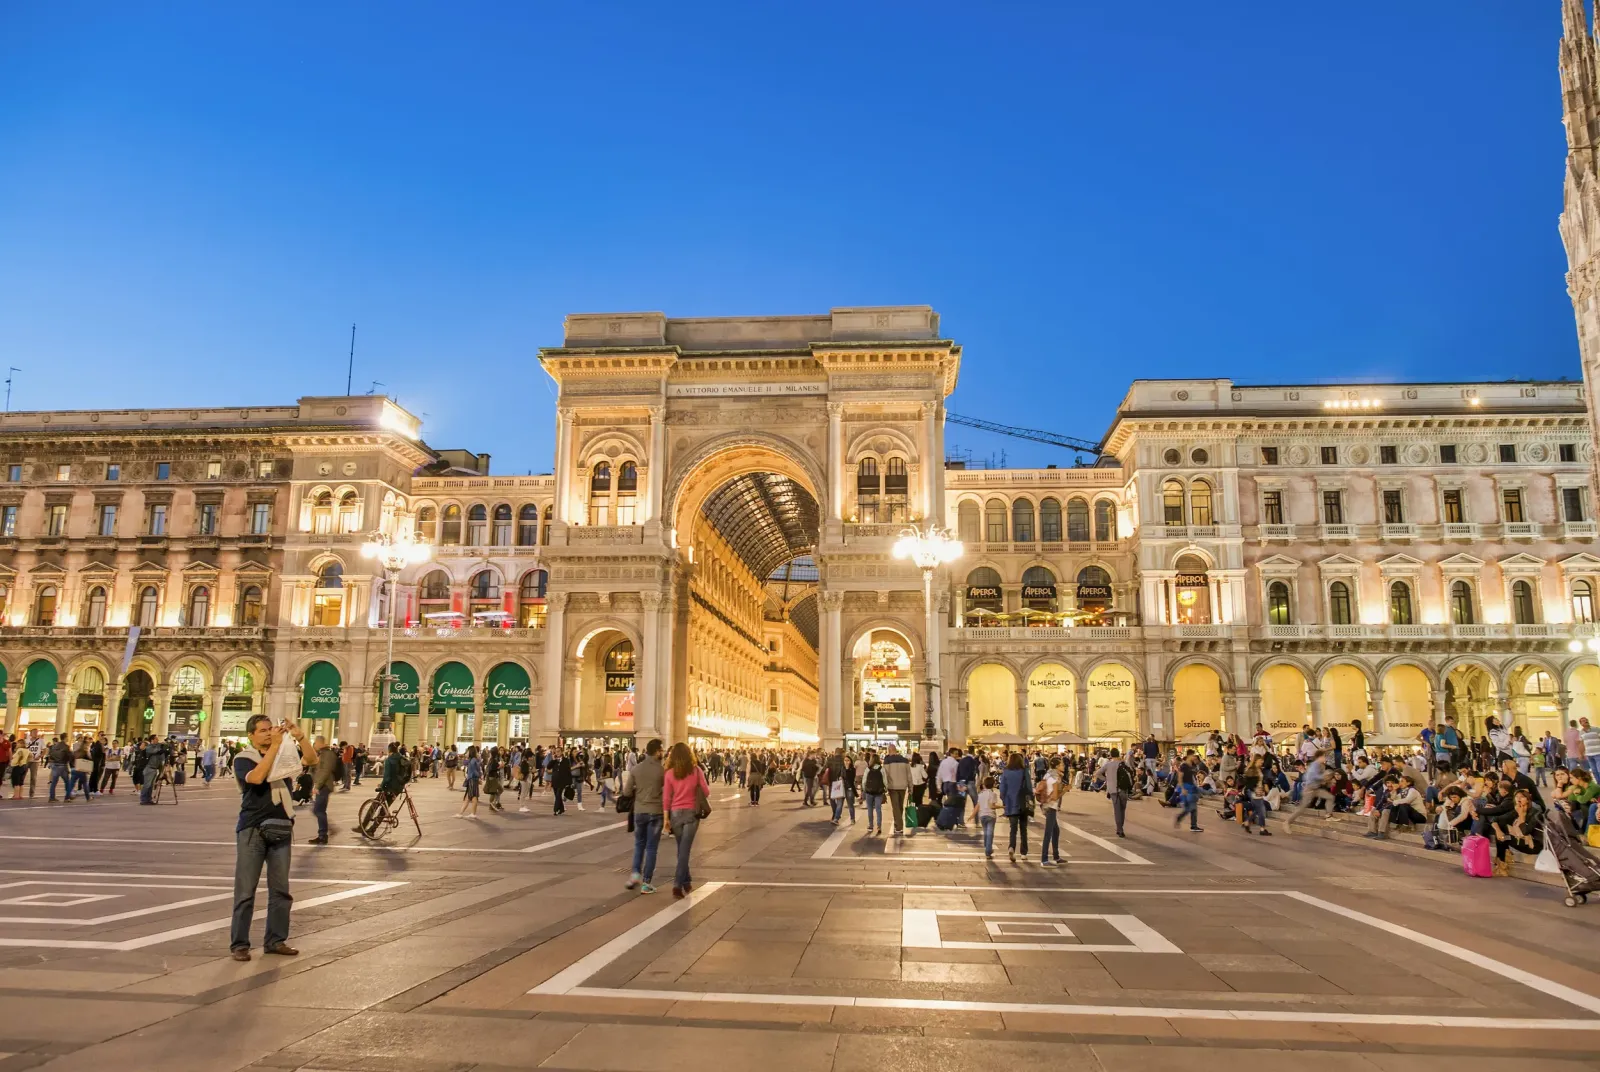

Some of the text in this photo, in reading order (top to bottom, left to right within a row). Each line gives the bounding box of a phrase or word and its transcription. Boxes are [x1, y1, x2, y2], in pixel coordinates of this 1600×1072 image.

[1175, 574, 1206, 584] APEROL
[970, 587, 998, 596] APEROL
[1024, 586, 1053, 595] APEROL
[1079, 586, 1108, 595] APEROL
[982, 719, 1004, 727] Motta
[1183, 720, 1211, 729] spizzico
[1269, 720, 1297, 729] spizzico
